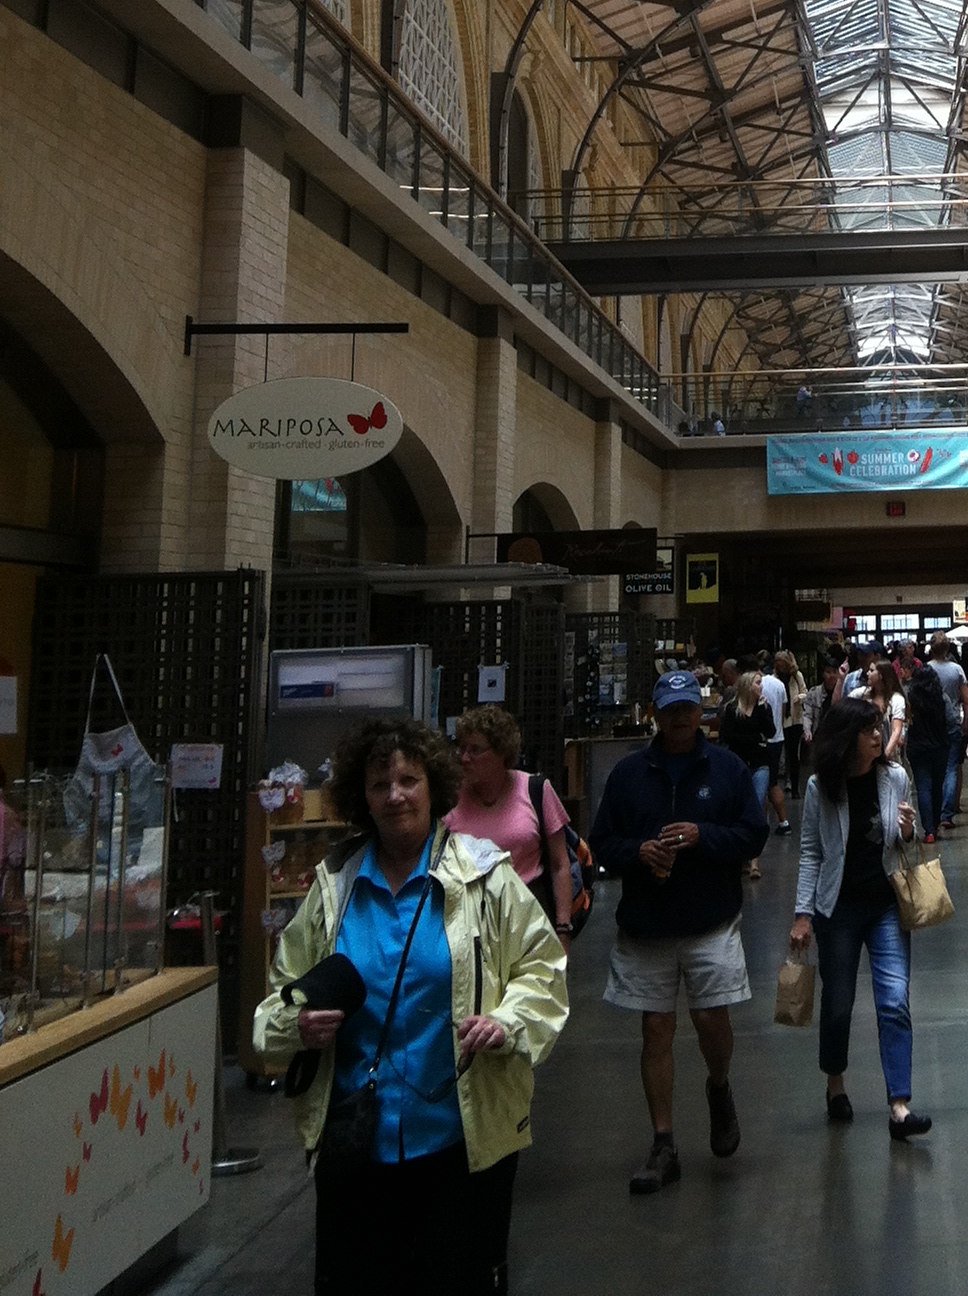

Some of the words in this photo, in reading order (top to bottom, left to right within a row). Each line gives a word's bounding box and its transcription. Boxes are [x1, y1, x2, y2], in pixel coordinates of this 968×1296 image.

[212, 417, 345, 438] MARIPOSA
[328, 438, 386, 451] gluten-free
[860, 451, 905, 465] SUMMER
[849, 462, 917, 477] CELEBRATION
[626, 572, 672, 581] STONEHOUSE
[625, 584, 653, 593] OLIVE
[655, 583, 672, 592] OIL
